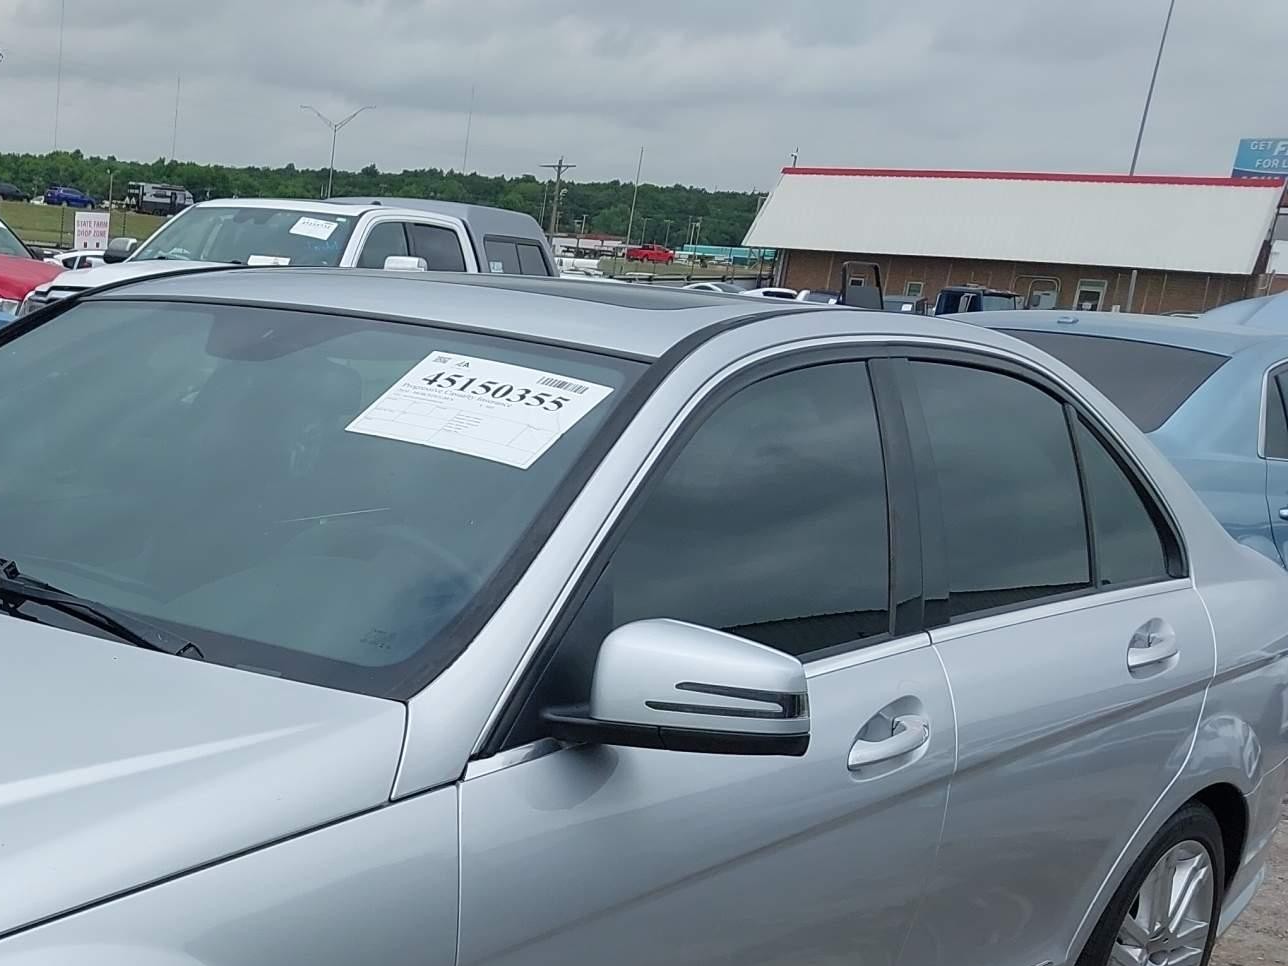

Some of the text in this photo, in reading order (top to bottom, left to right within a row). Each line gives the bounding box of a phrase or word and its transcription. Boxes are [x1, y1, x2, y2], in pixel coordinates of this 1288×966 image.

[1249, 141, 1273, 150] GET
[1255, 159, 1279, 168] FOR
[76, 220, 108, 229] STATE FARM
[93, 230, 106, 238] ZONE
[421, 371, 570, 411] 45150355
